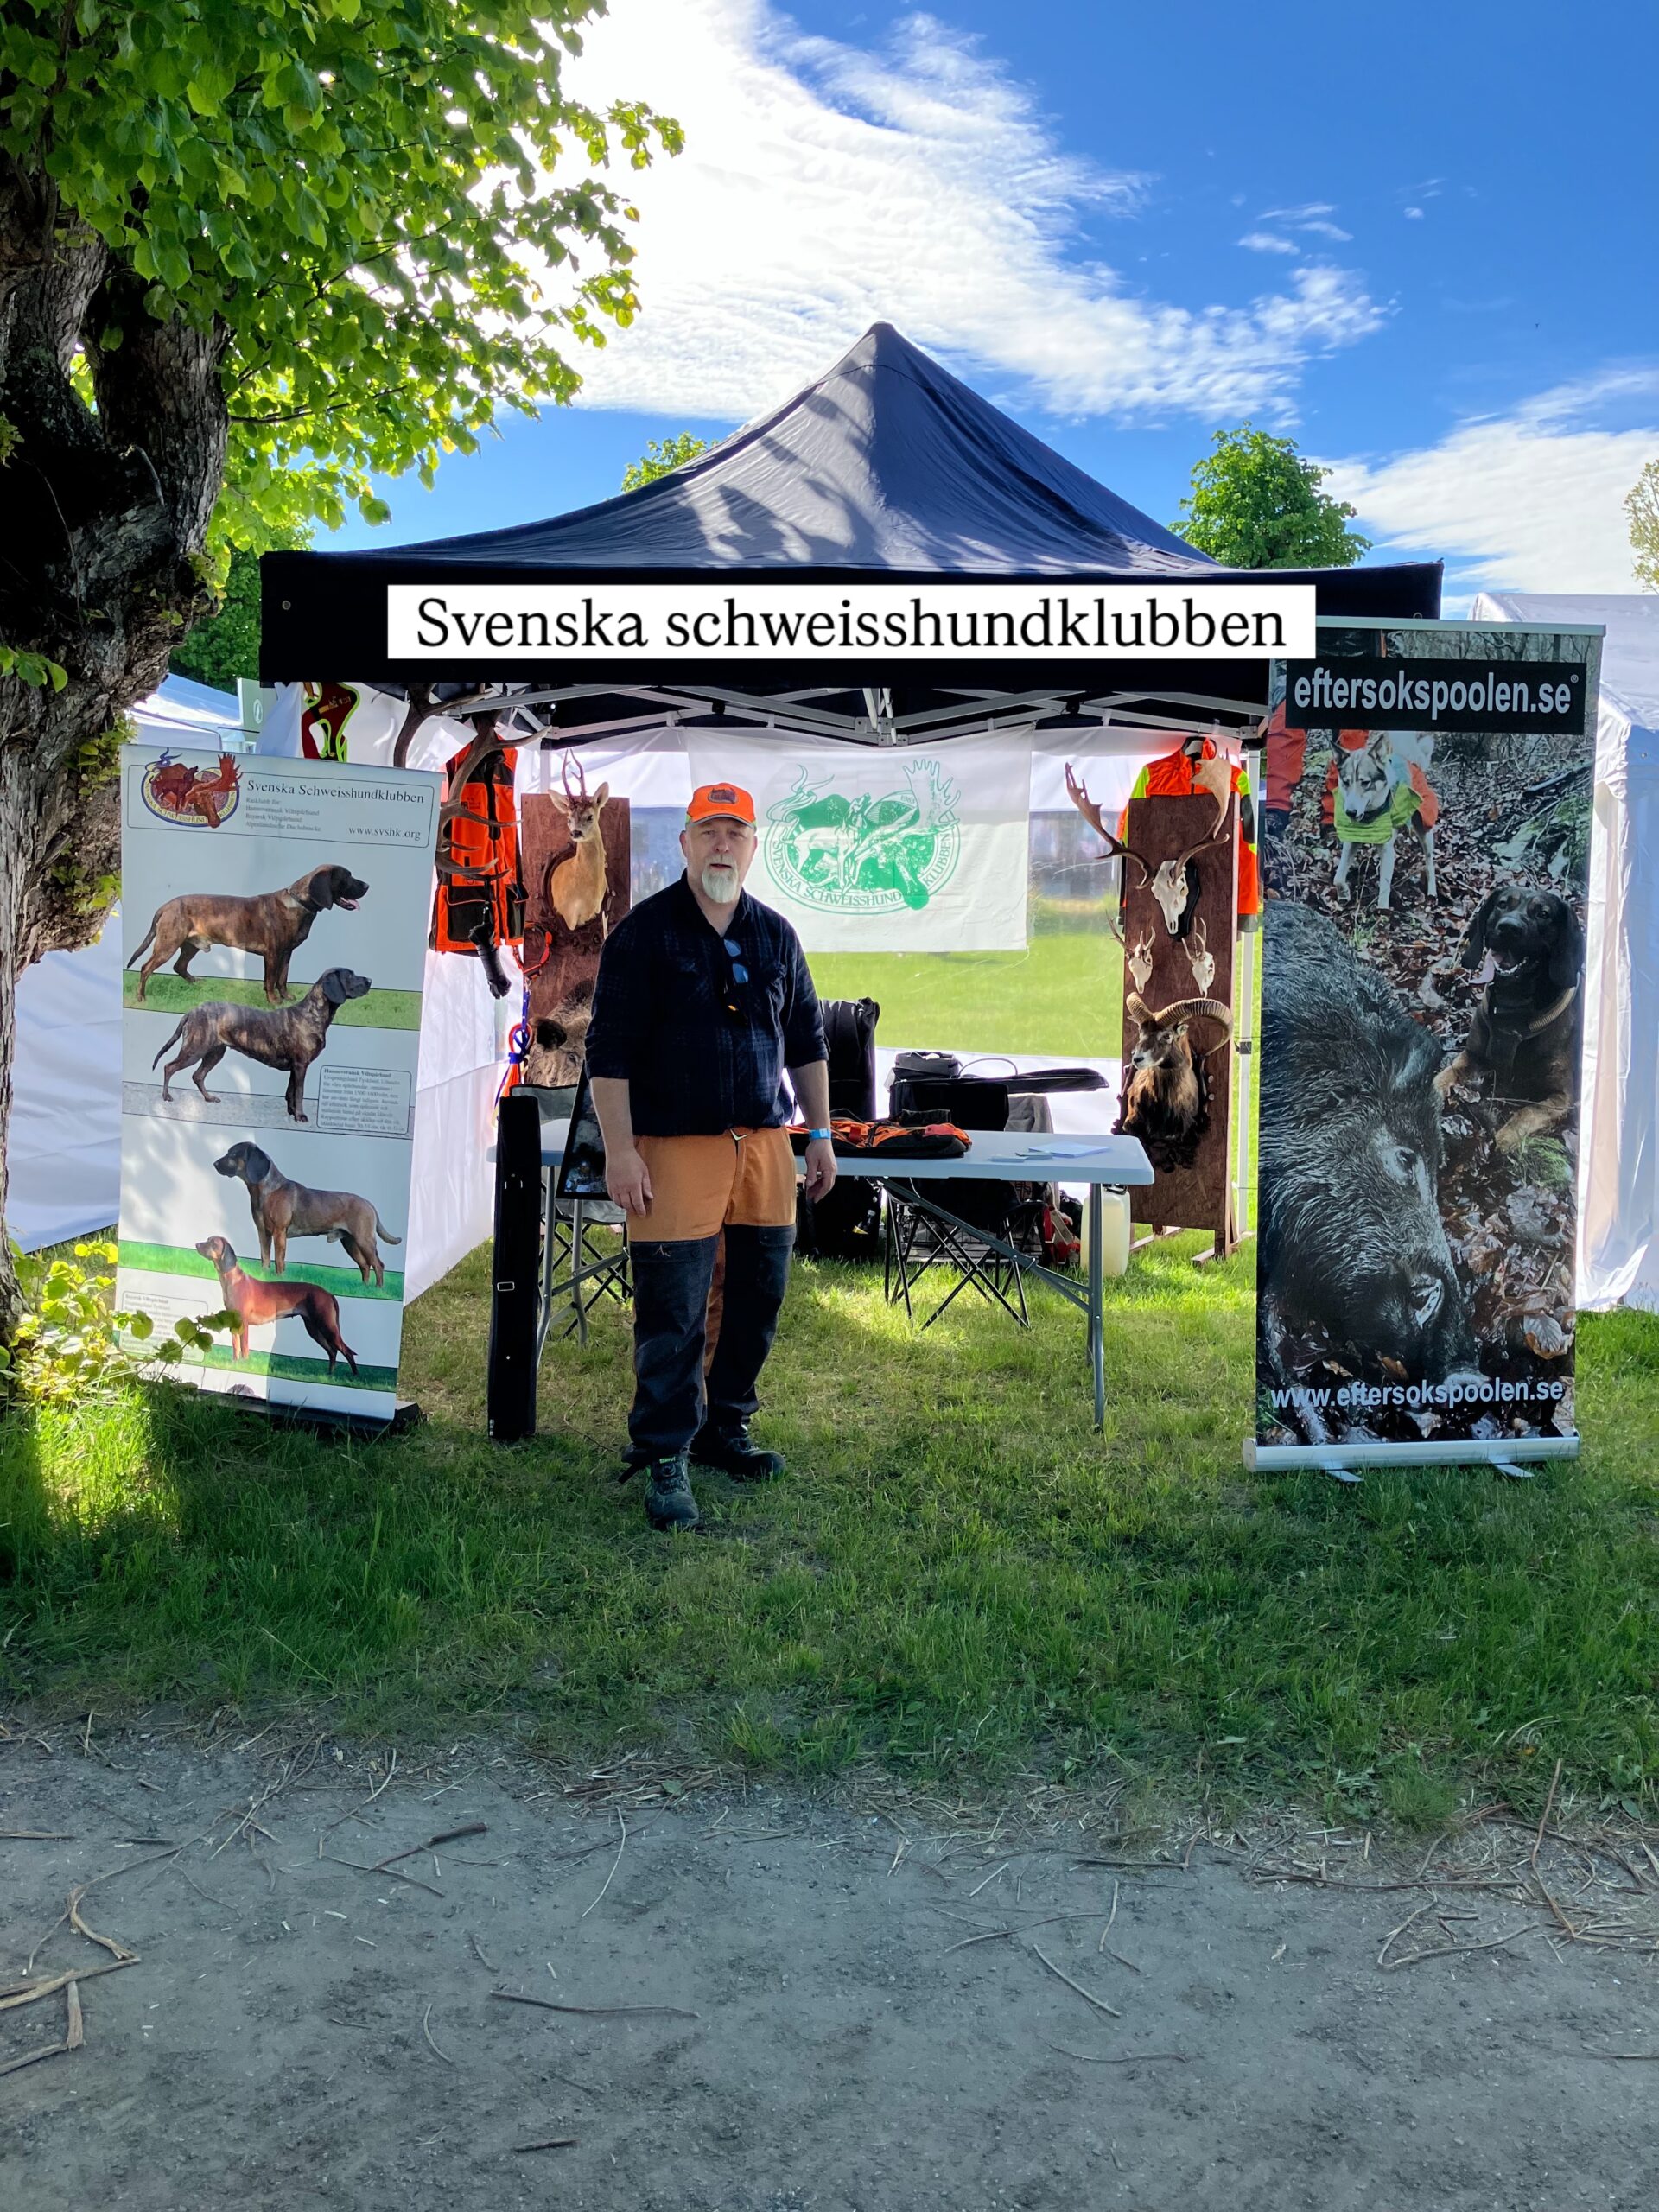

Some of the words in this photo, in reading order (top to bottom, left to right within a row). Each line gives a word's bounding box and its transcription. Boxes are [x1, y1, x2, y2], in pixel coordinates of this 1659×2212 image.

[246, 779, 296, 794] Svenska
[298, 784, 424, 804] Schweisshundklubben
[348, 825, 421, 842] www.svshk.org
[772, 841, 803, 893] SVENSKA
[803, 887, 902, 906] SCHWEISSHUND
[922, 832, 951, 887] KLUBBEN
[1270, 1376, 1565, 1409] www.eftersokspoolen.se
